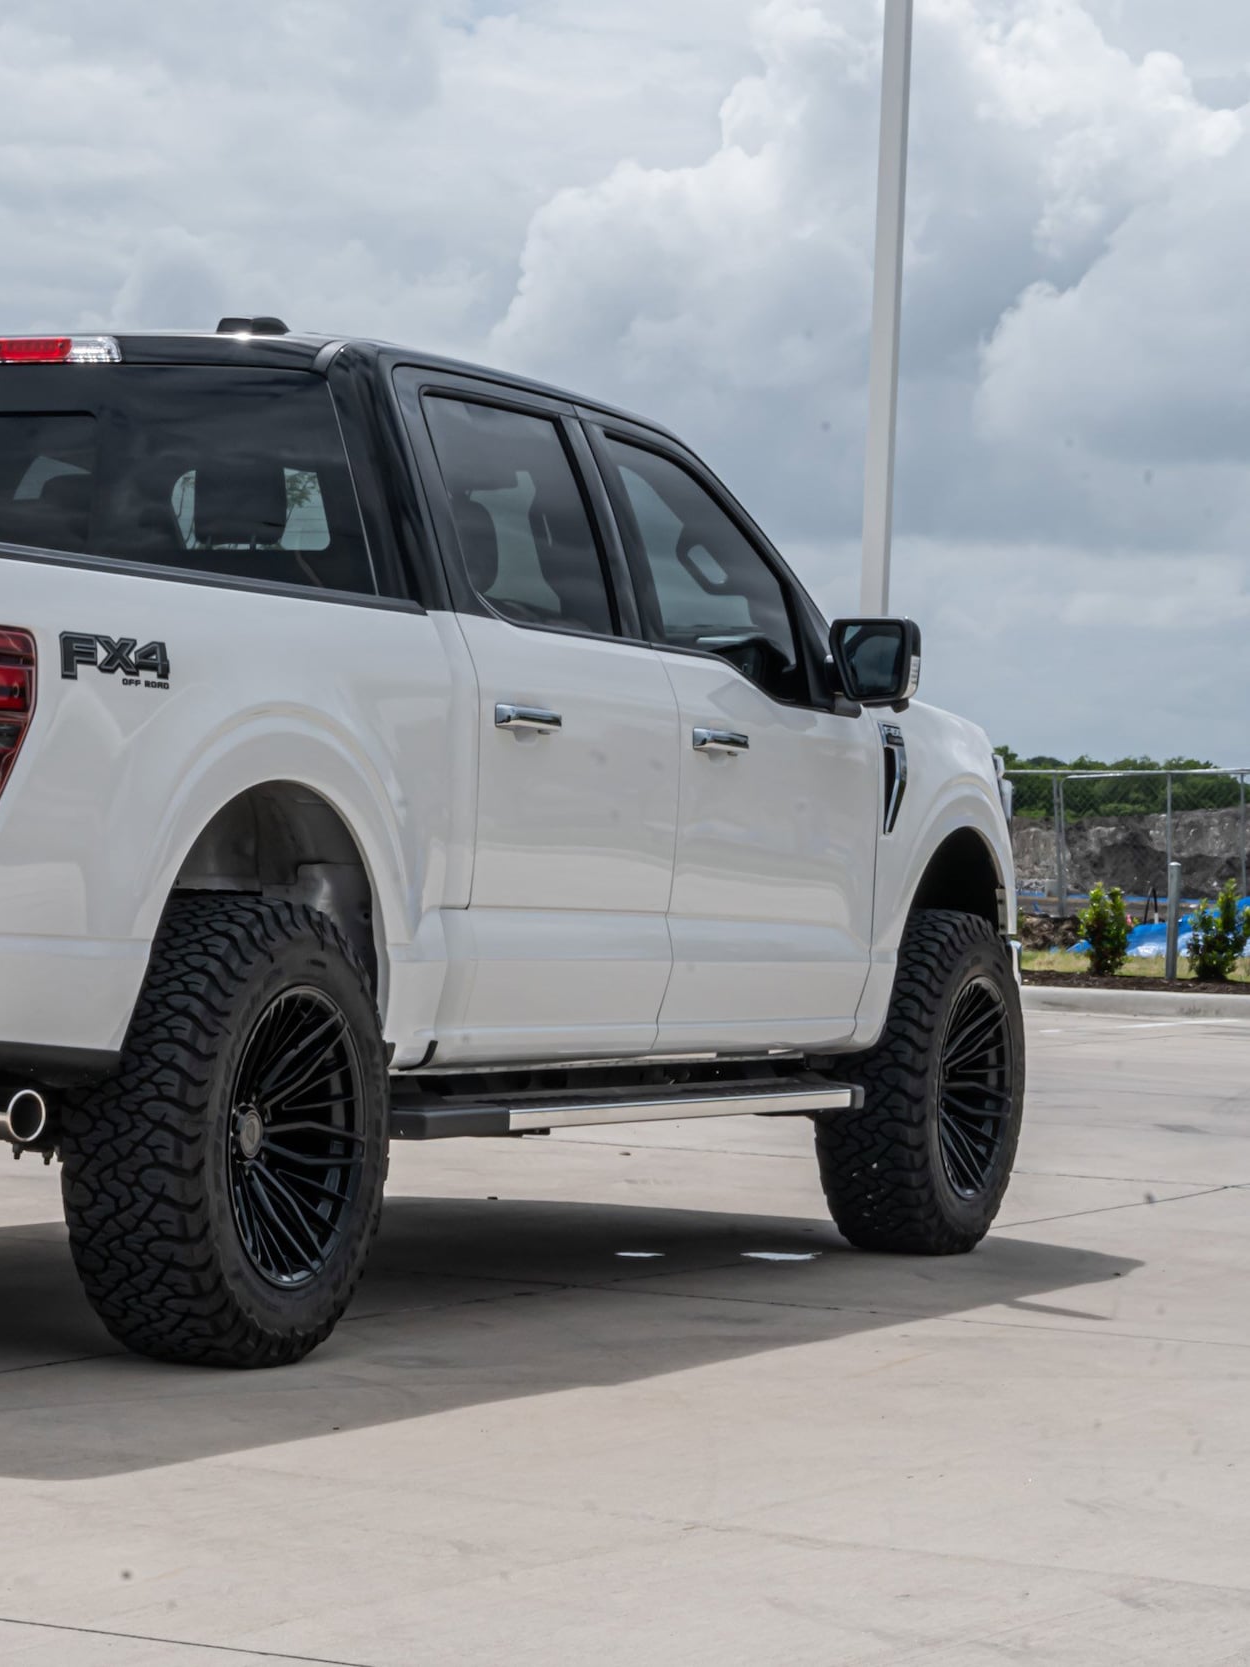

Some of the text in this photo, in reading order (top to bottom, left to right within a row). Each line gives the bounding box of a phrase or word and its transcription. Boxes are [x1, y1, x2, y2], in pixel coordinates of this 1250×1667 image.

[59, 631, 170, 680] FX4
[122, 678, 170, 690] OFF ROAD
